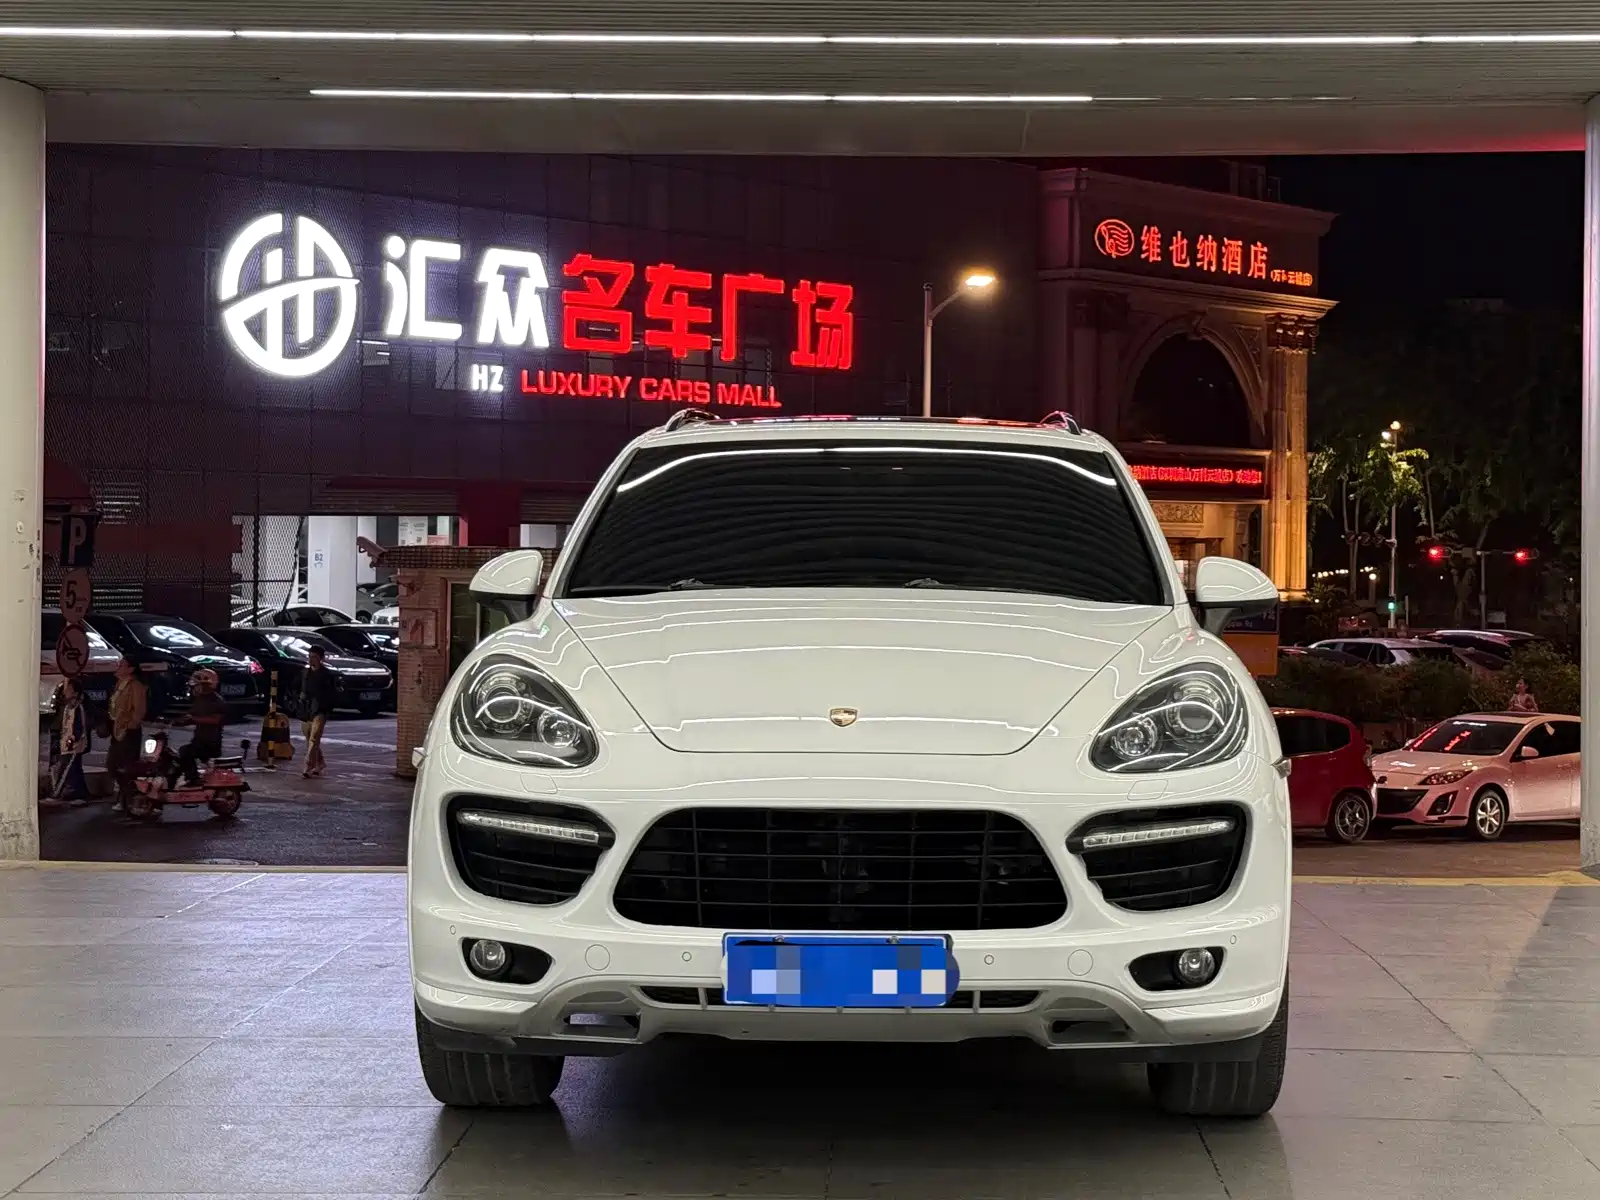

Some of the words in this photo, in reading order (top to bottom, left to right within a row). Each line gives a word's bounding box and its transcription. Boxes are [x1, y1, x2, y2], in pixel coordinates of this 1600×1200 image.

[1141, 225, 1268, 279] 维也纳酒店
[383, 235, 853, 370] 汇众名车广场
[471, 364, 504, 392] HZ
[521, 369, 633, 399] LUXURY
[640, 377, 711, 404] CARS
[717, 383, 781, 407] MALL
[67, 516, 88, 565] P
[314, 553, 324, 562] B2
[64, 580, 77, 609] 5
